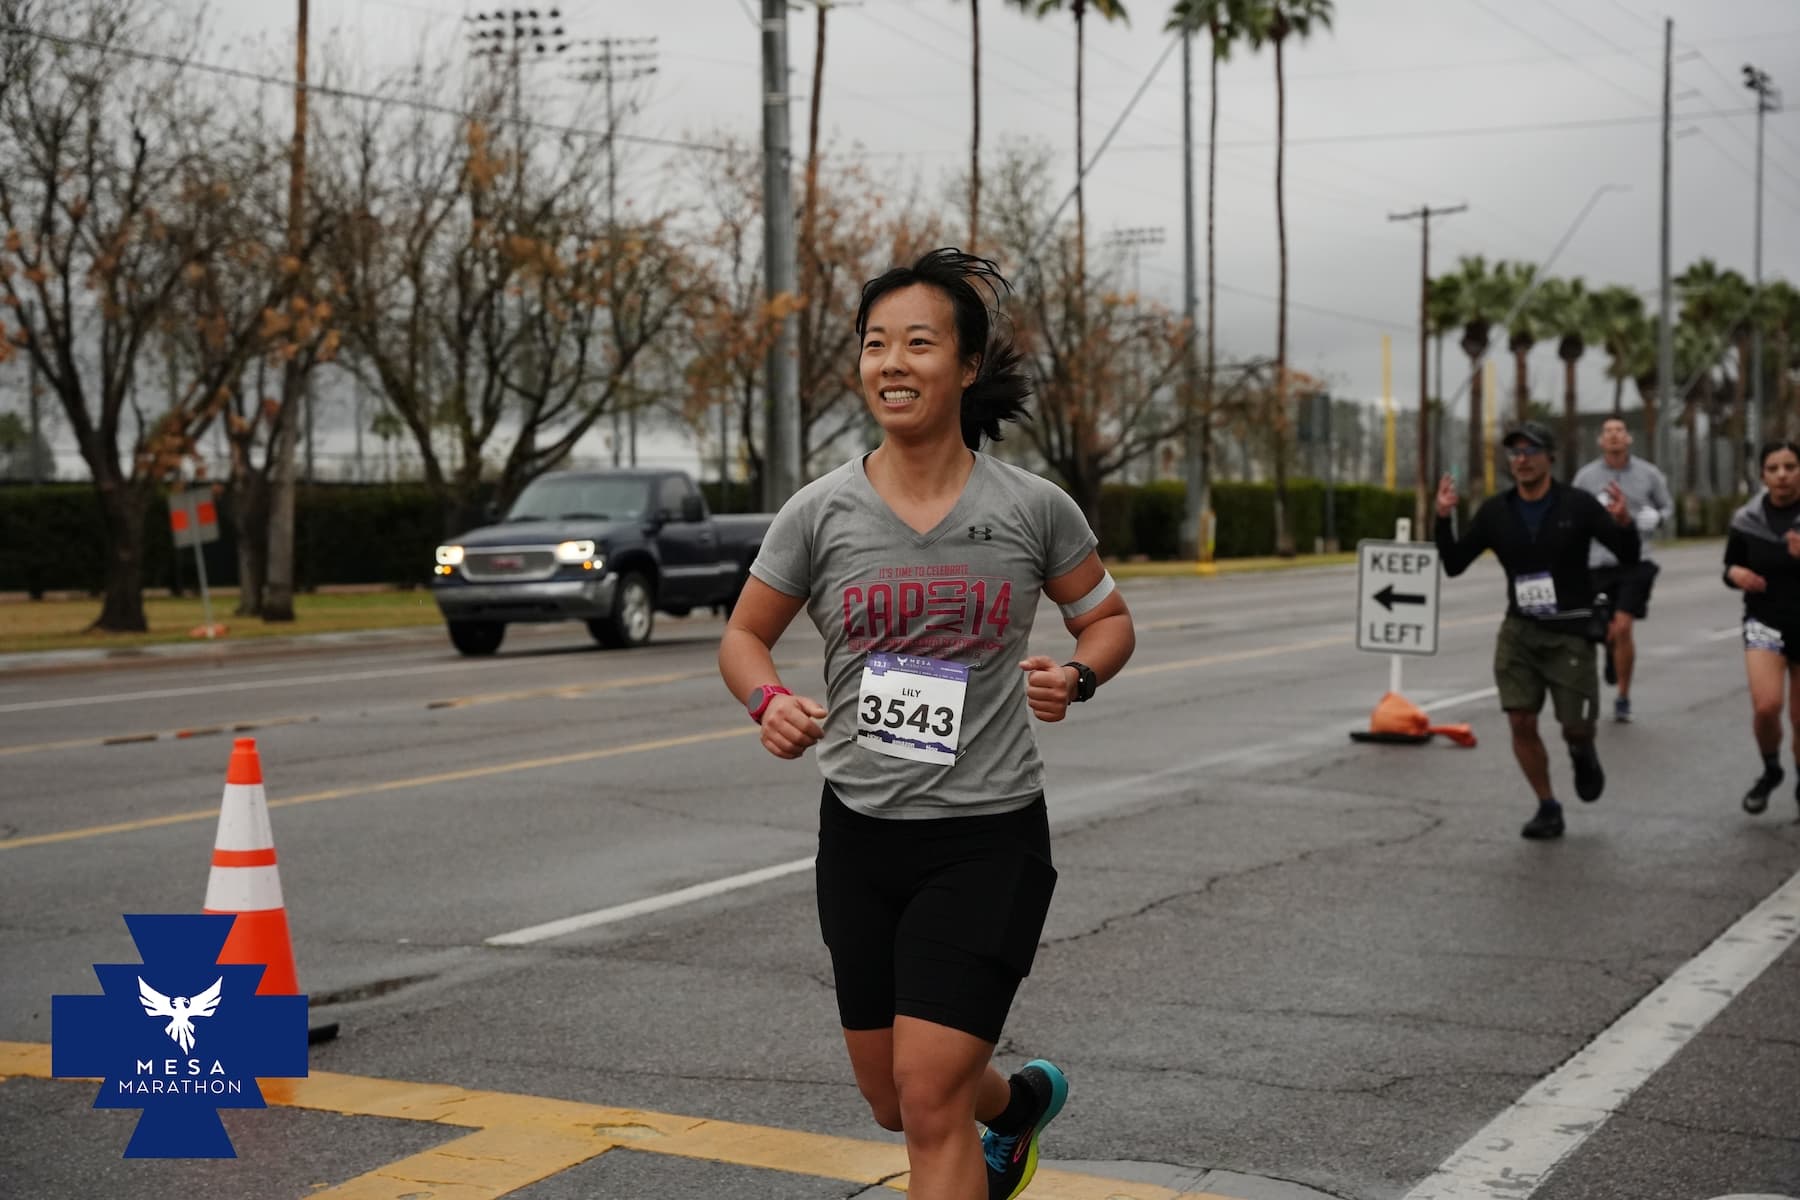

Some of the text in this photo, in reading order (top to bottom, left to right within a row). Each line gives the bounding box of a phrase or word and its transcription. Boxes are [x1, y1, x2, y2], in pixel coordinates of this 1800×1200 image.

[895, 566, 912, 578] TIME
[915, 566, 925, 577] TO
[1370, 551, 1431, 575] KEEP
[843, 581, 925, 638] CAP
[970, 579, 1012, 638] 14
[1369, 621, 1425, 645] LEFT
[910, 658, 932, 667] MESA
[902, 687, 921, 698] LILY
[861, 695, 954, 737] 3543
